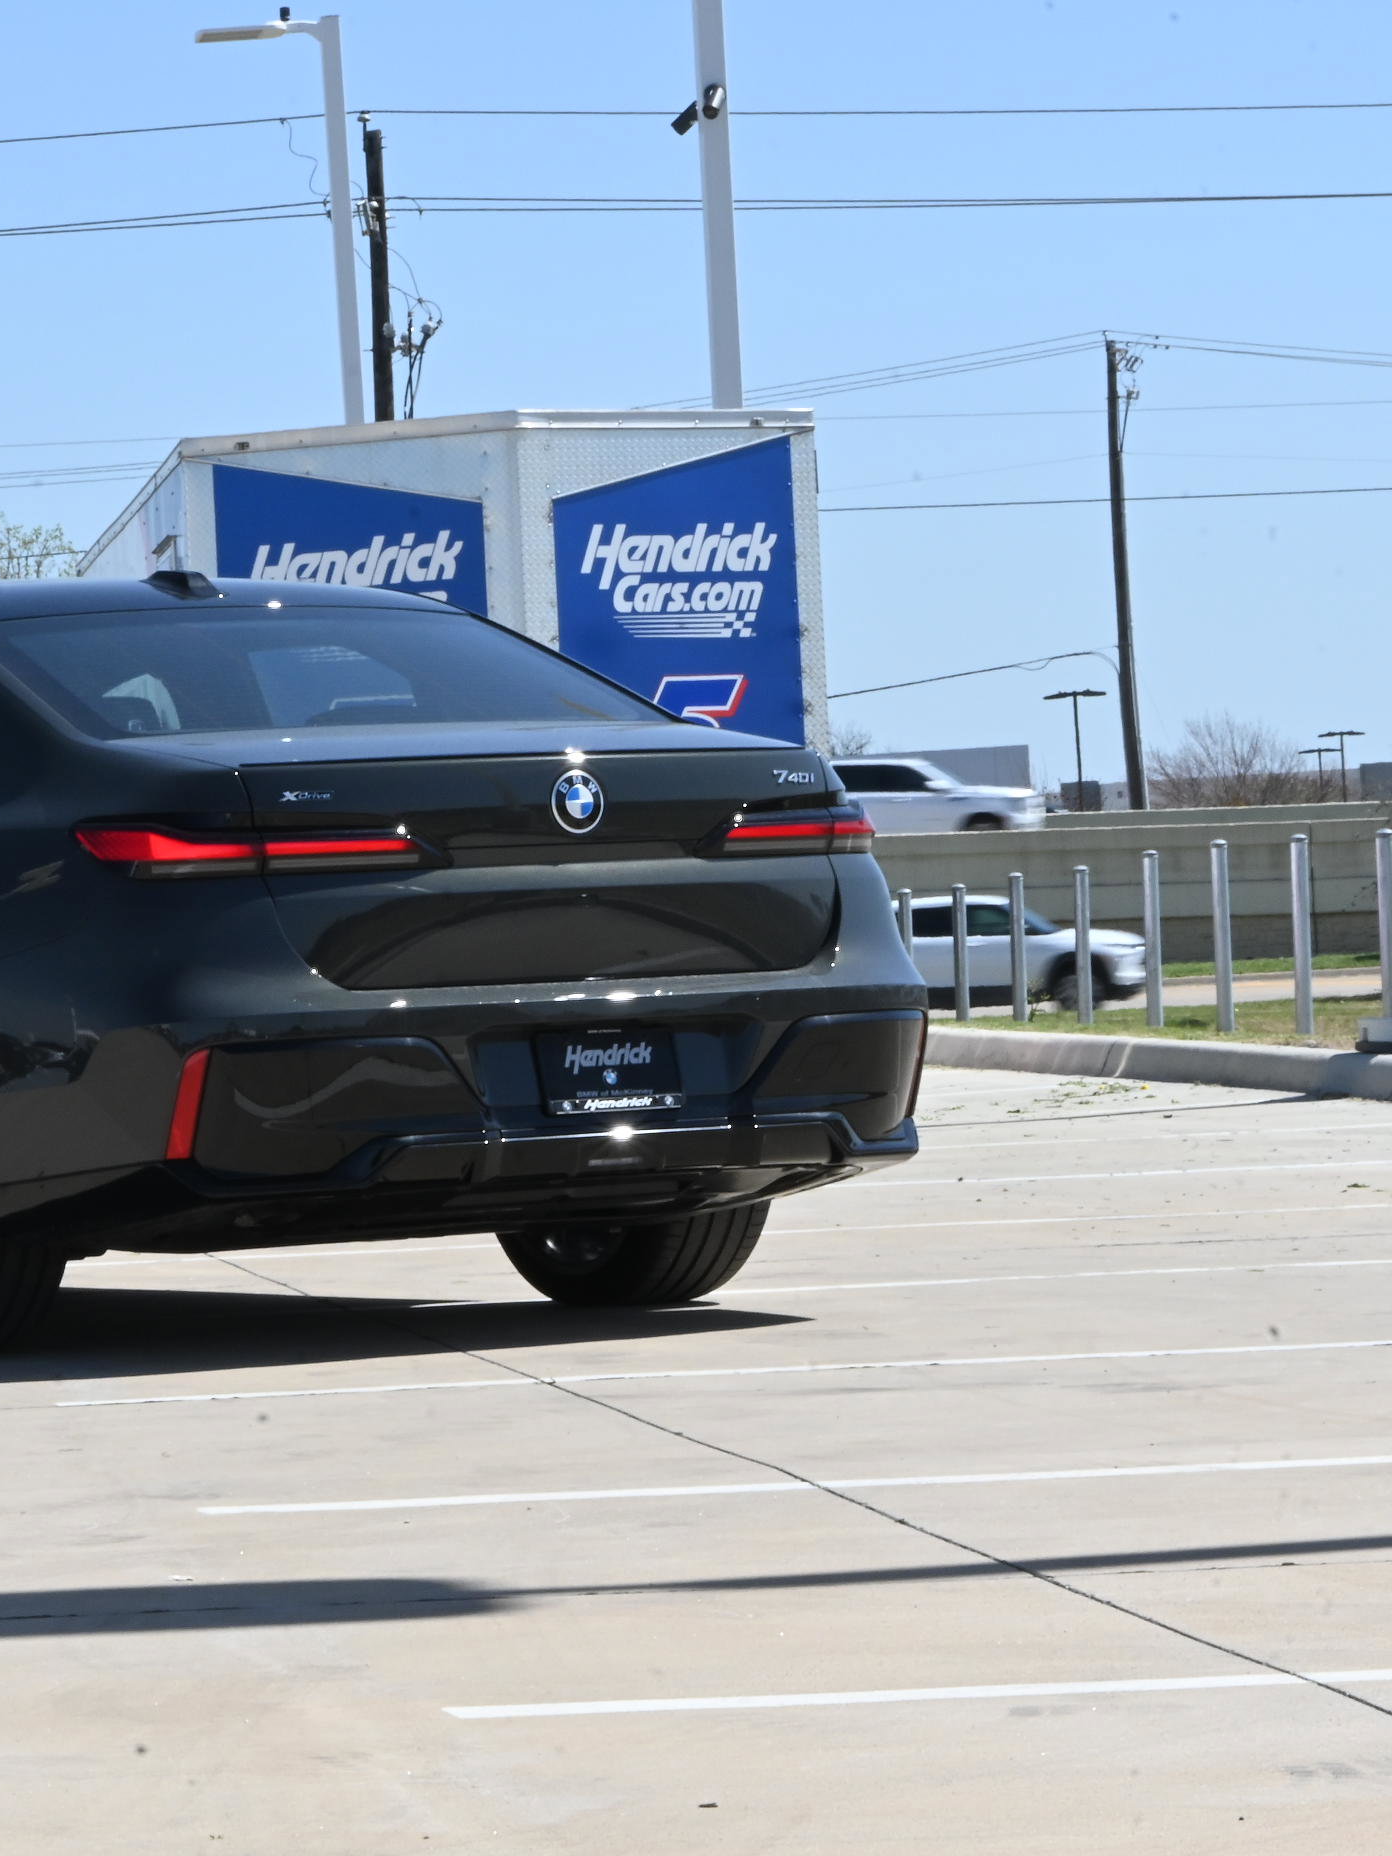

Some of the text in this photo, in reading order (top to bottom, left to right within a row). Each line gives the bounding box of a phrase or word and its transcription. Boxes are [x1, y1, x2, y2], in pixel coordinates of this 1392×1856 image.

[250, 530, 464, 587] Hendrick
[581, 522, 778, 590] Hendrick
[613, 574, 764, 613] Cars.com
[558, 775, 598, 794] BMW
[564, 1042, 653, 1075] Hendrick
[584, 1097, 653, 1111] Hendrick
